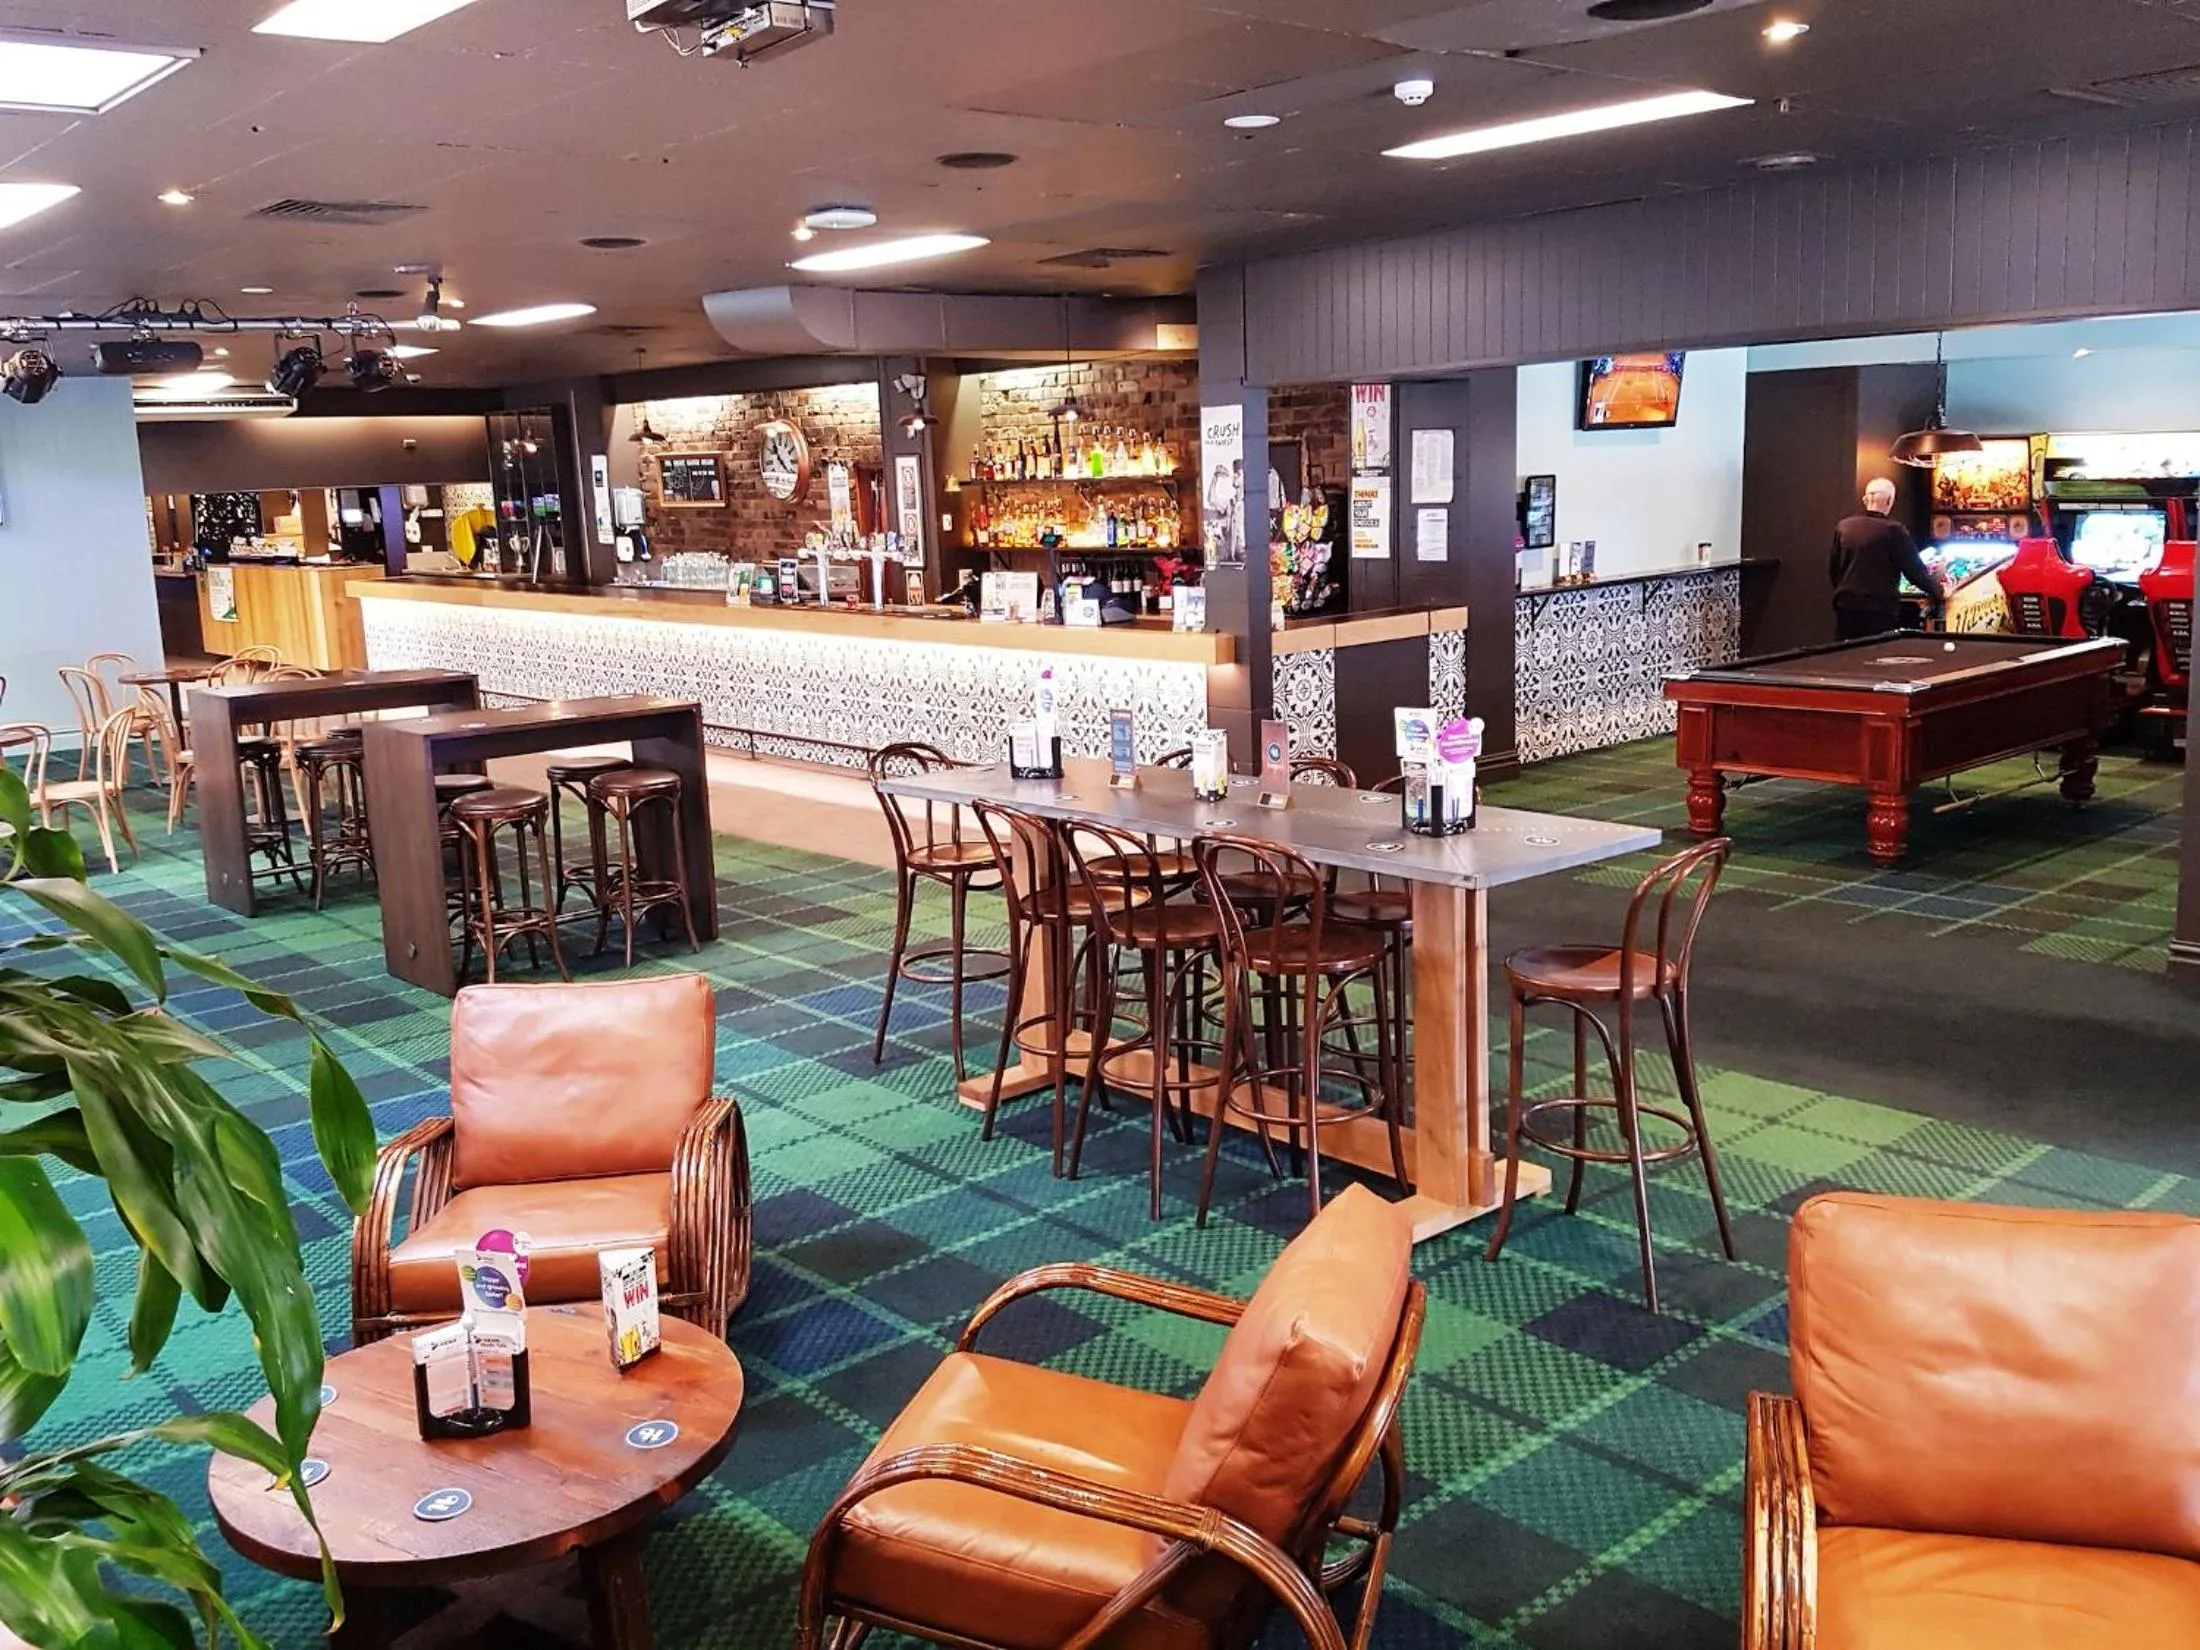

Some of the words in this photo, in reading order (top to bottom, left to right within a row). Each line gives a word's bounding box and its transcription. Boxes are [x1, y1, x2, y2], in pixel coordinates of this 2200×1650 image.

[1356, 384, 1385, 403] WIN
[1207, 422, 1240, 439] CRUSH
[624, 1281, 649, 1309] WIN
